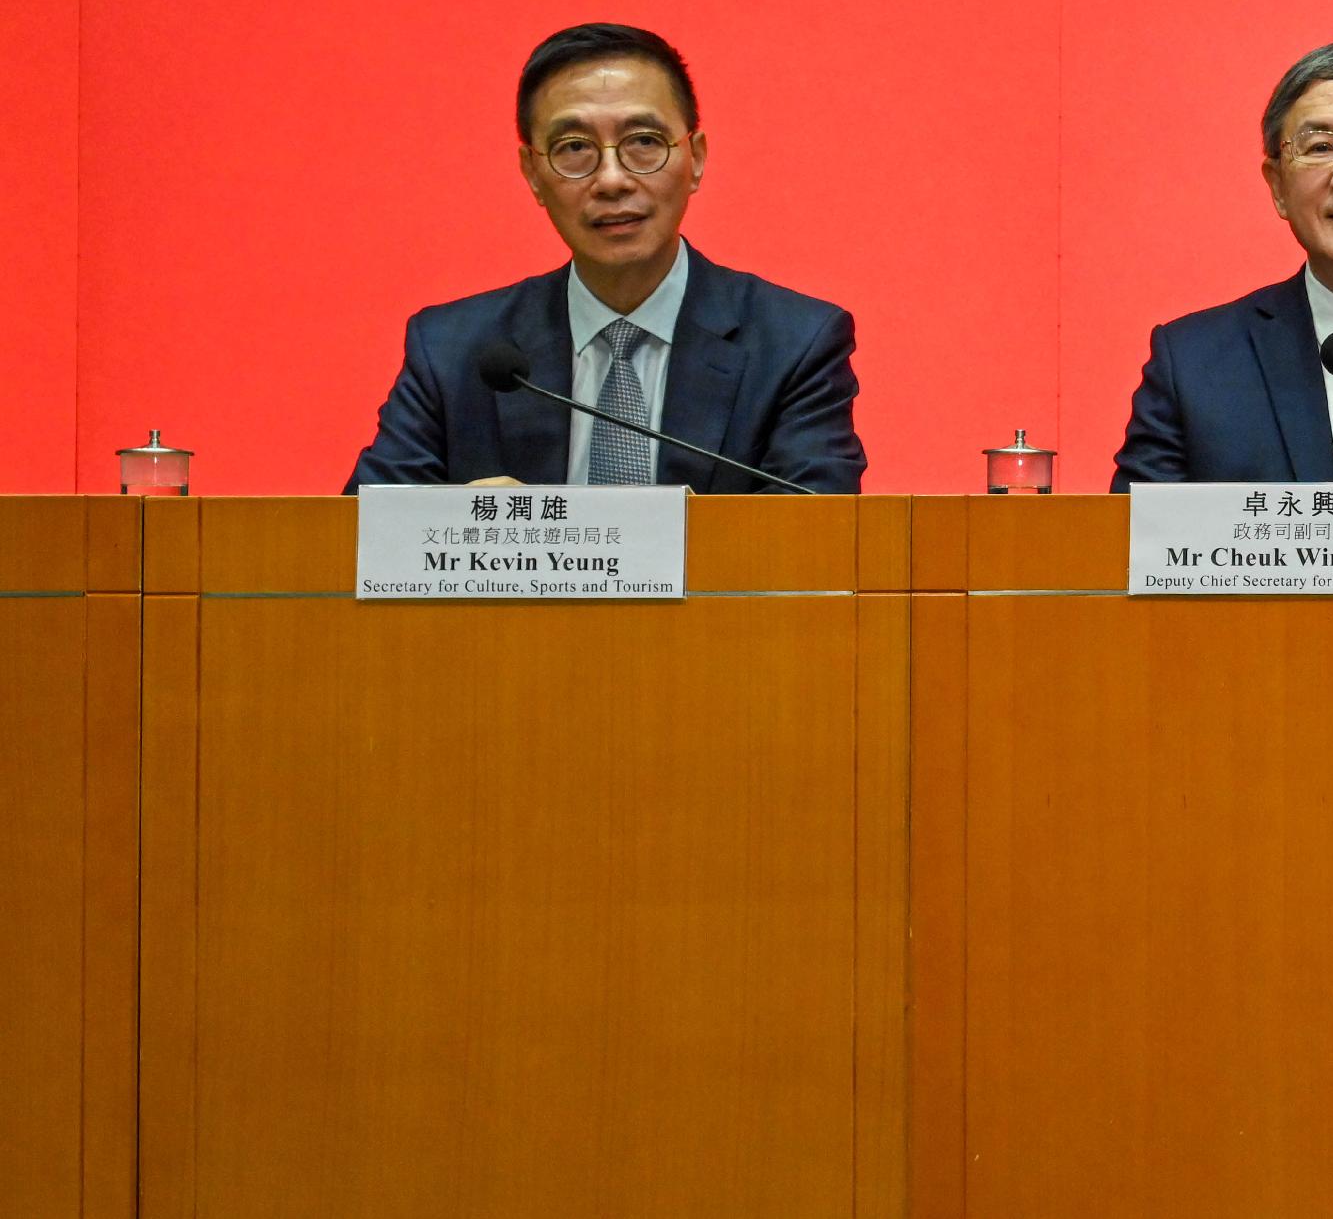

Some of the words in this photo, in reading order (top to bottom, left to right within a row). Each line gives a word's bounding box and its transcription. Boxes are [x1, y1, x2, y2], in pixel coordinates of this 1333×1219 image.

[471, 495, 568, 522] 楊潤雄
[422, 527, 622, 545] 文化體育及旅遊局局長
[423, 551, 461, 571] Mr
[468, 551, 538, 571] Kevin
[546, 551, 620, 577] Yeung
[1165, 547, 1203, 567] Mr
[1210, 547, 1287, 567] Cheuk
[363, 579, 433, 595] Secretary
[438, 579, 460, 593] for
[464, 579, 524, 595] Culture,
[530, 579, 577, 595] Sports
[581, 579, 608, 593] and
[612, 579, 673, 593] Tourism
[1145, 575, 1194, 589] Deputy
[1199, 575, 1239, 587] Chief
[1242, 575, 1307, 589] Secretary
[1313, 575, 1333, 587] for
